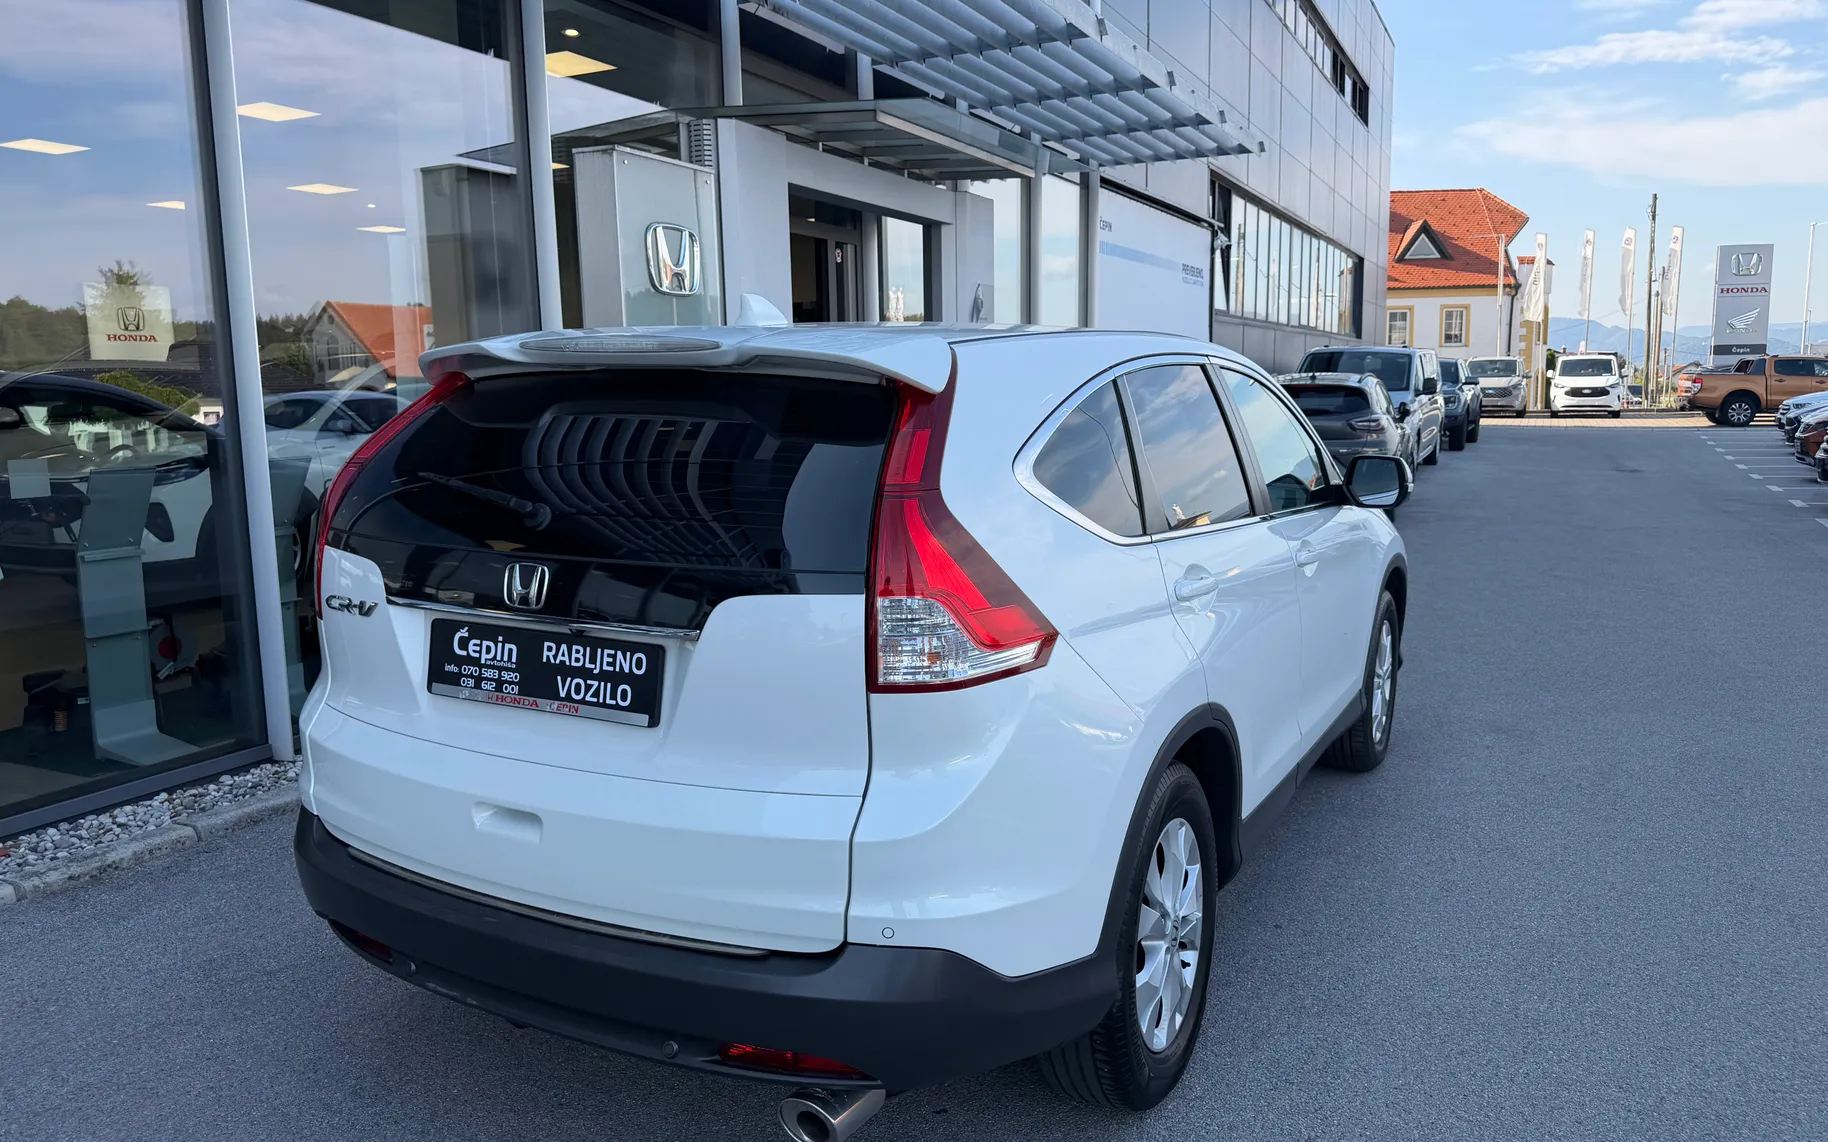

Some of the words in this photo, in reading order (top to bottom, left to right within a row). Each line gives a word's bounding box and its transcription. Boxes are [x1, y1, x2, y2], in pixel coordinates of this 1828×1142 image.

[106, 334, 158, 342] HONDA
[325, 594, 379, 617] CR-V
[453, 626, 518, 664] Čepin
[485, 660, 516, 669] avtohiša
[542, 641, 647, 675] RABLJENO
[444, 663, 460, 673] info:
[461, 665, 479, 676] 070
[481, 668, 499, 679] 583
[501, 670, 520, 682] 920
[460, 677, 475, 688] 031
[481, 680, 496, 691] 612
[502, 683, 519, 695] 001
[557, 675, 632, 707] VOZILO
[495, 694, 539, 708] HONDA
